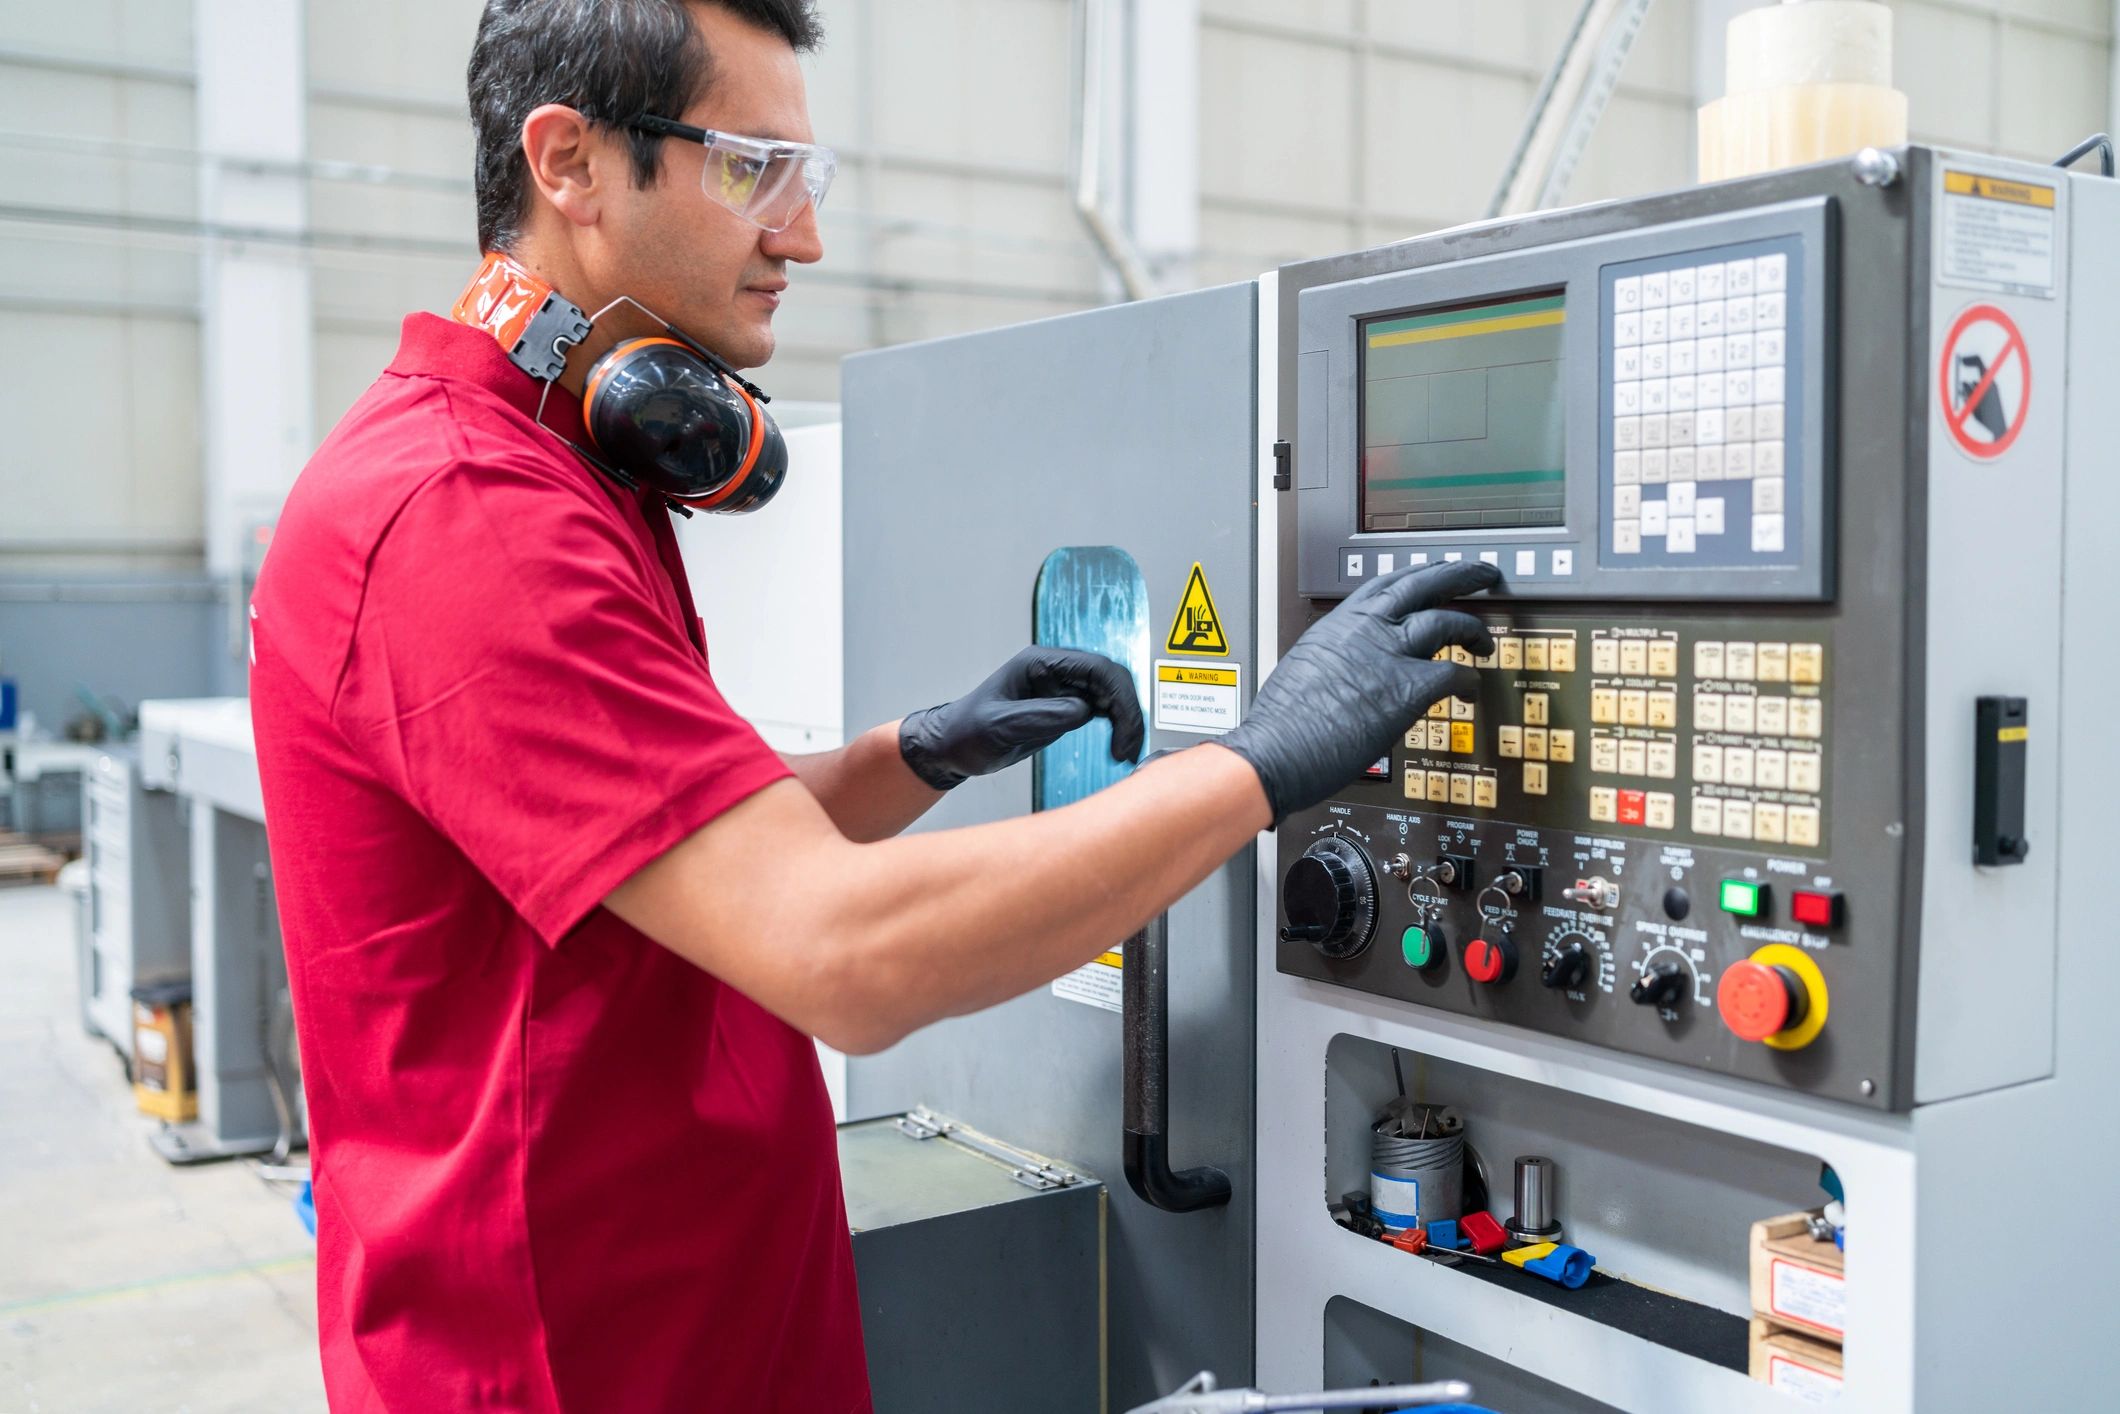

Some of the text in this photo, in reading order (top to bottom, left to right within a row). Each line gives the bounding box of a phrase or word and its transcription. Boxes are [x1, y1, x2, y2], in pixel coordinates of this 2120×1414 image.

[1189, 672, 1219, 682] WARNING
[1454, 763, 1480, 771] OVERRIDE
[1330, 806, 1351, 815] HANDLE
[1387, 813, 1421, 824] HANDLE AXIS
[1446, 821, 1475, 831] PROGRAM
[1516, 829, 1538, 838] POWER
[1517, 837, 1538, 847] CHUCK
[1574, 852, 1590, 861] AUTO
[1767, 858, 1807, 875] POWER
[1412, 893, 1429, 903] CYCLE
[1485, 905, 1500, 914] FEED
[1543, 906, 1577, 920] FEEDRATE
[1740, 924, 1829, 949] EMERGENCY STOP
